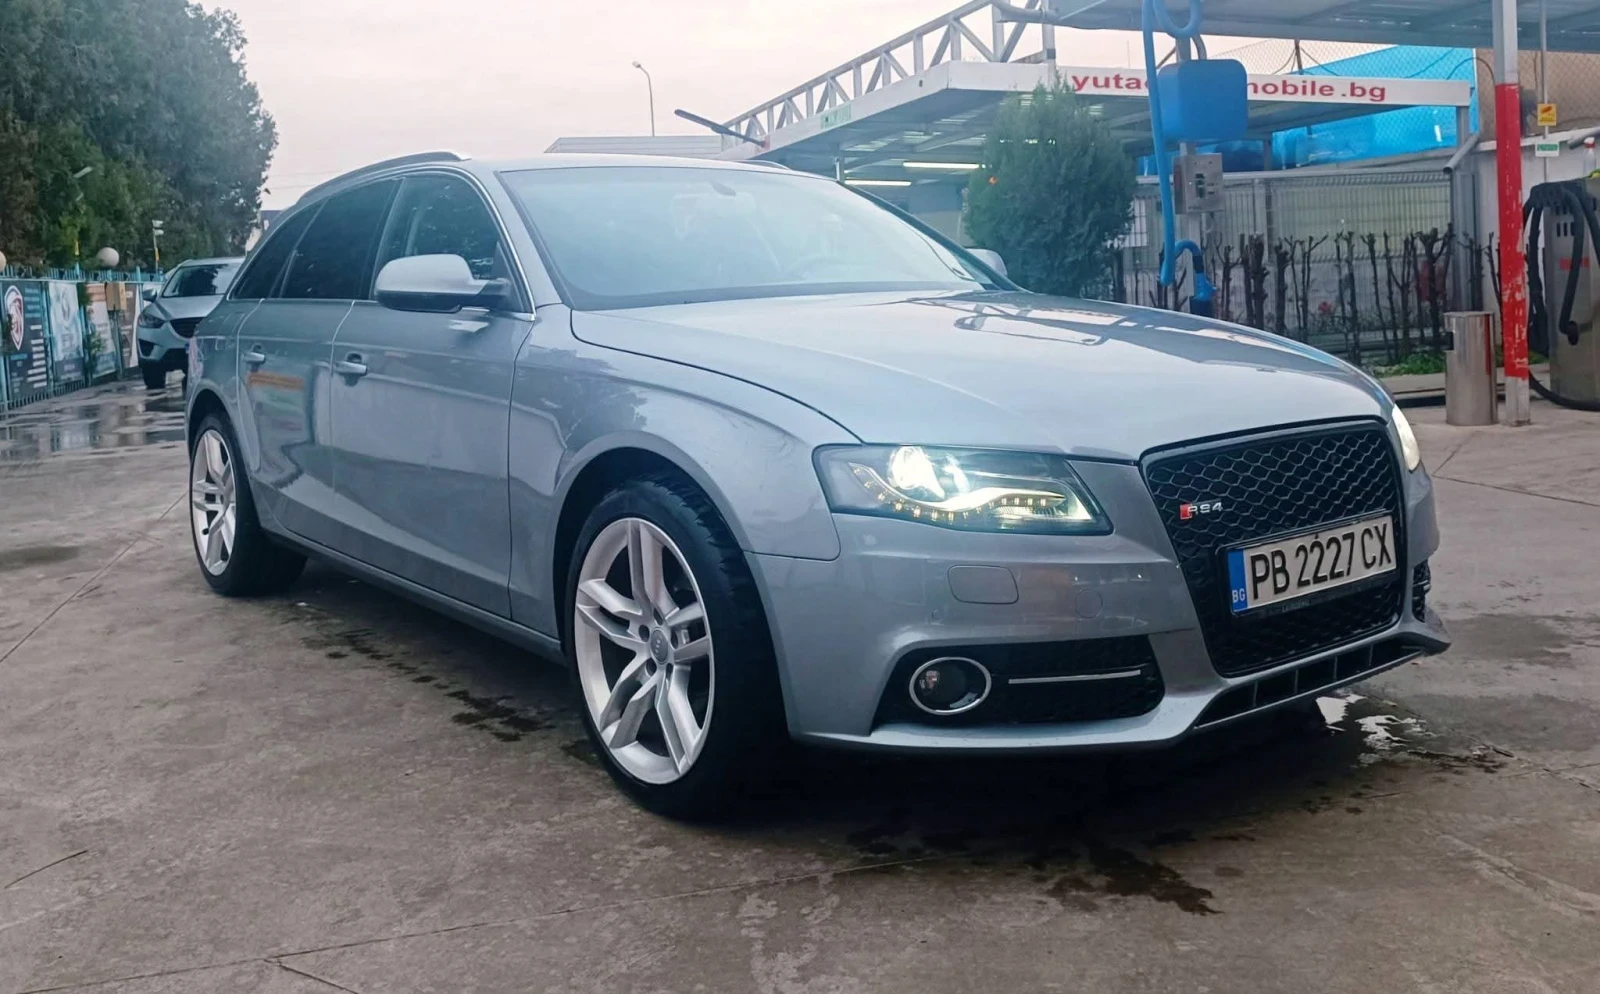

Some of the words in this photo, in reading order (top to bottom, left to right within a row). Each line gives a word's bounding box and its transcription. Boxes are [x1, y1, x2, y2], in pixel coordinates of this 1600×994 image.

[1072, 73, 1149, 91] yuta
[1184, 502, 1222, 517] RS4
[1250, 549, 1290, 600] PB
[1295, 532, 1355, 588] 2227
[1361, 523, 1392, 569] CX
[1231, 589, 1246, 603] BG
